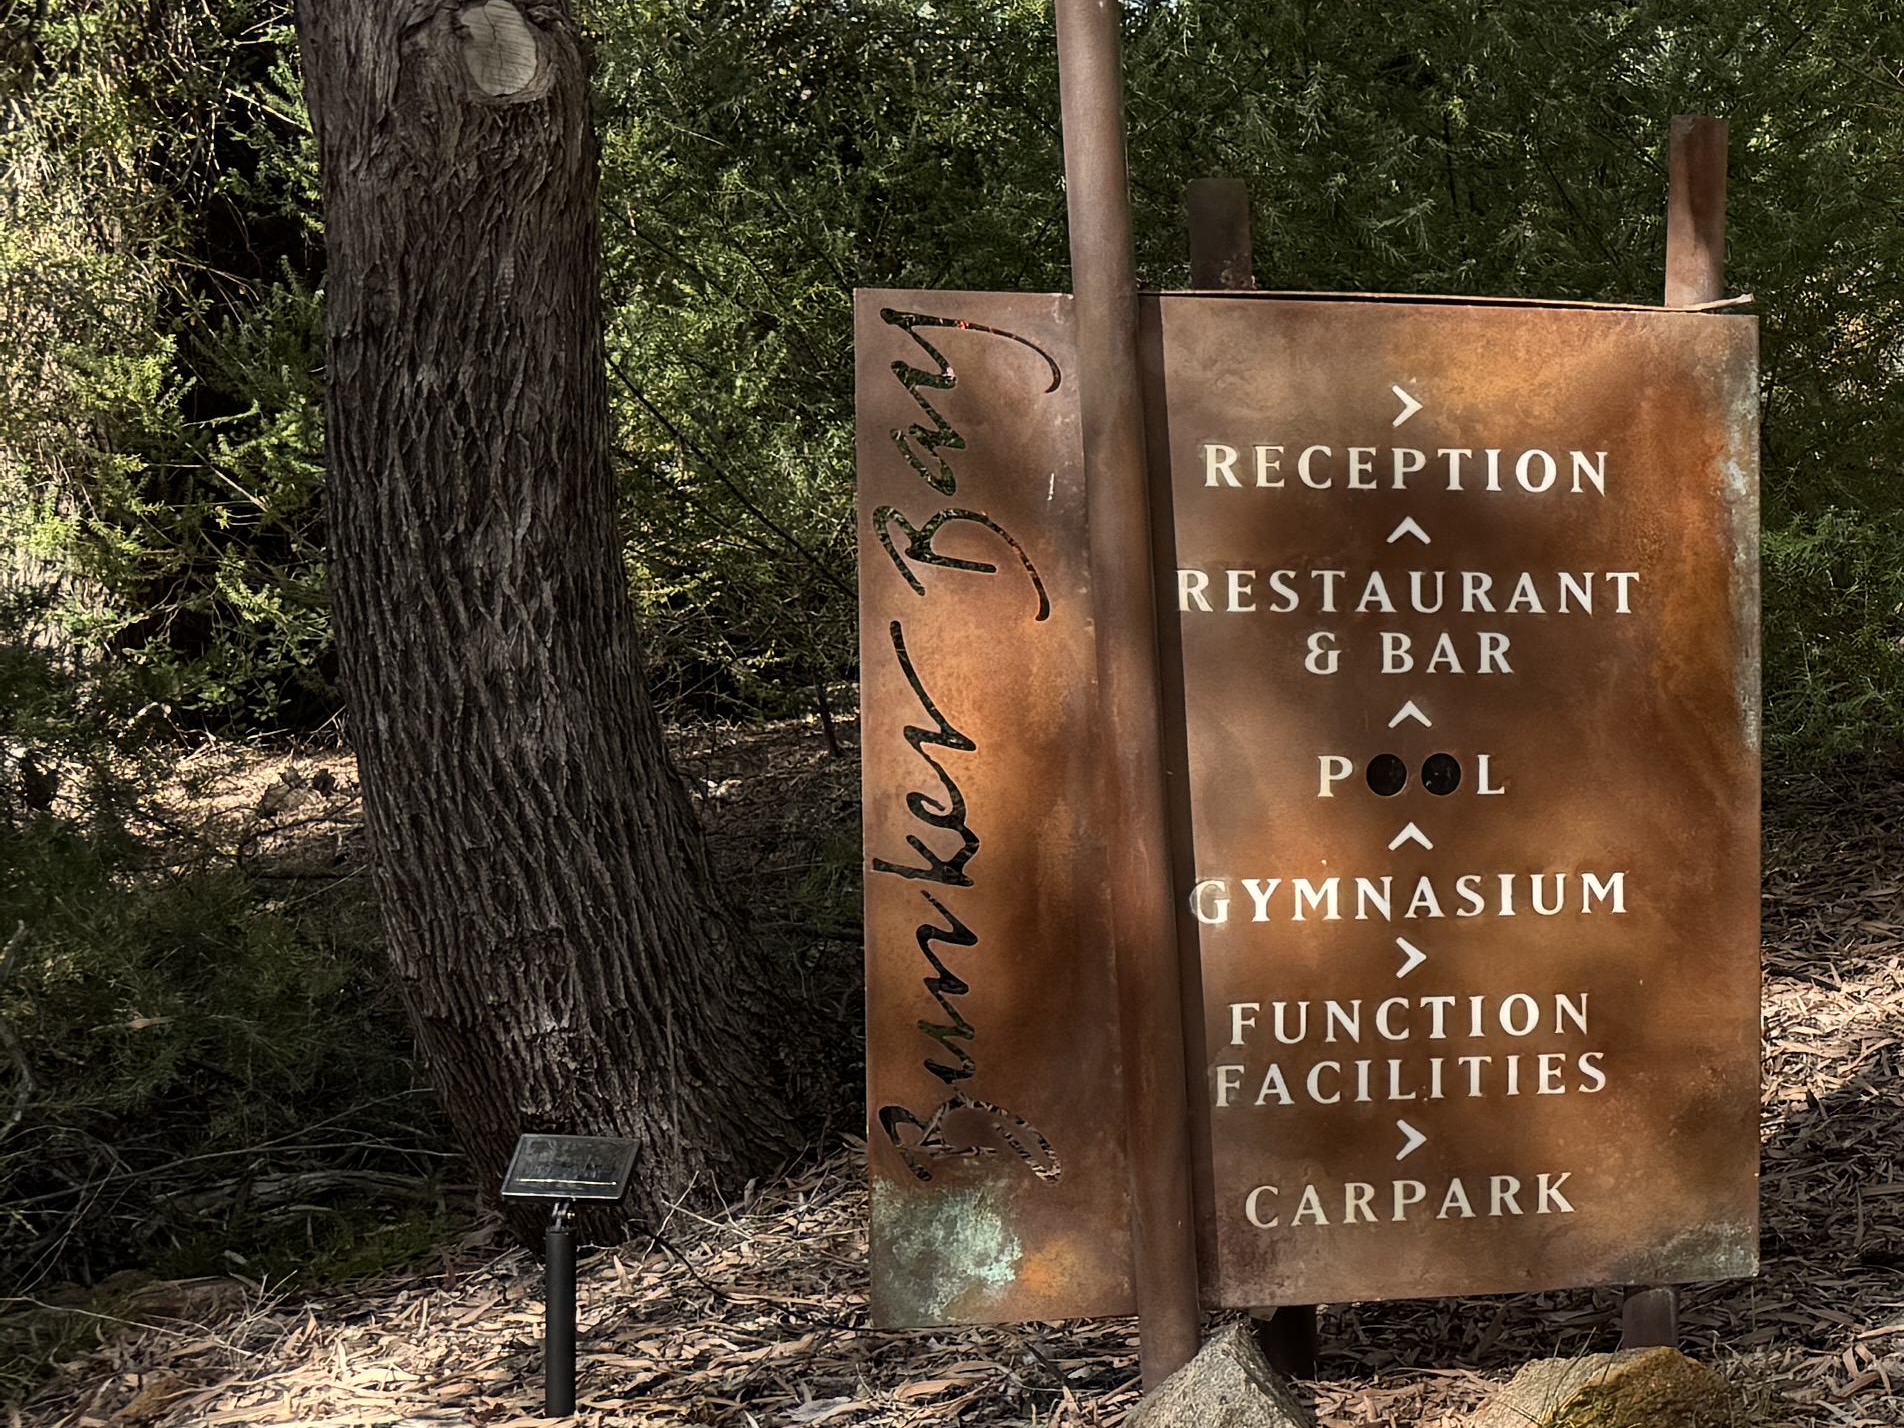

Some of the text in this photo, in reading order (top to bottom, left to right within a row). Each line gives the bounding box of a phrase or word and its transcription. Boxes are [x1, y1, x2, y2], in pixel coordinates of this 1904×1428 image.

[1203, 445, 1608, 496] RECEPTION
[1176, 570, 1640, 615] RESTAURANT
[1304, 632, 1514, 675] & BAR
[872, 306, 1062, 1185] Bunker Bay
[1317, 754, 1505, 798] POOL
[1190, 873, 1627, 925] GYMNASIUM
[1229, 993, 1589, 1046] FUNCTION
[1216, 1052, 1606, 1107] FACILITIES
[1245, 1172, 1575, 1228] CARPARK
